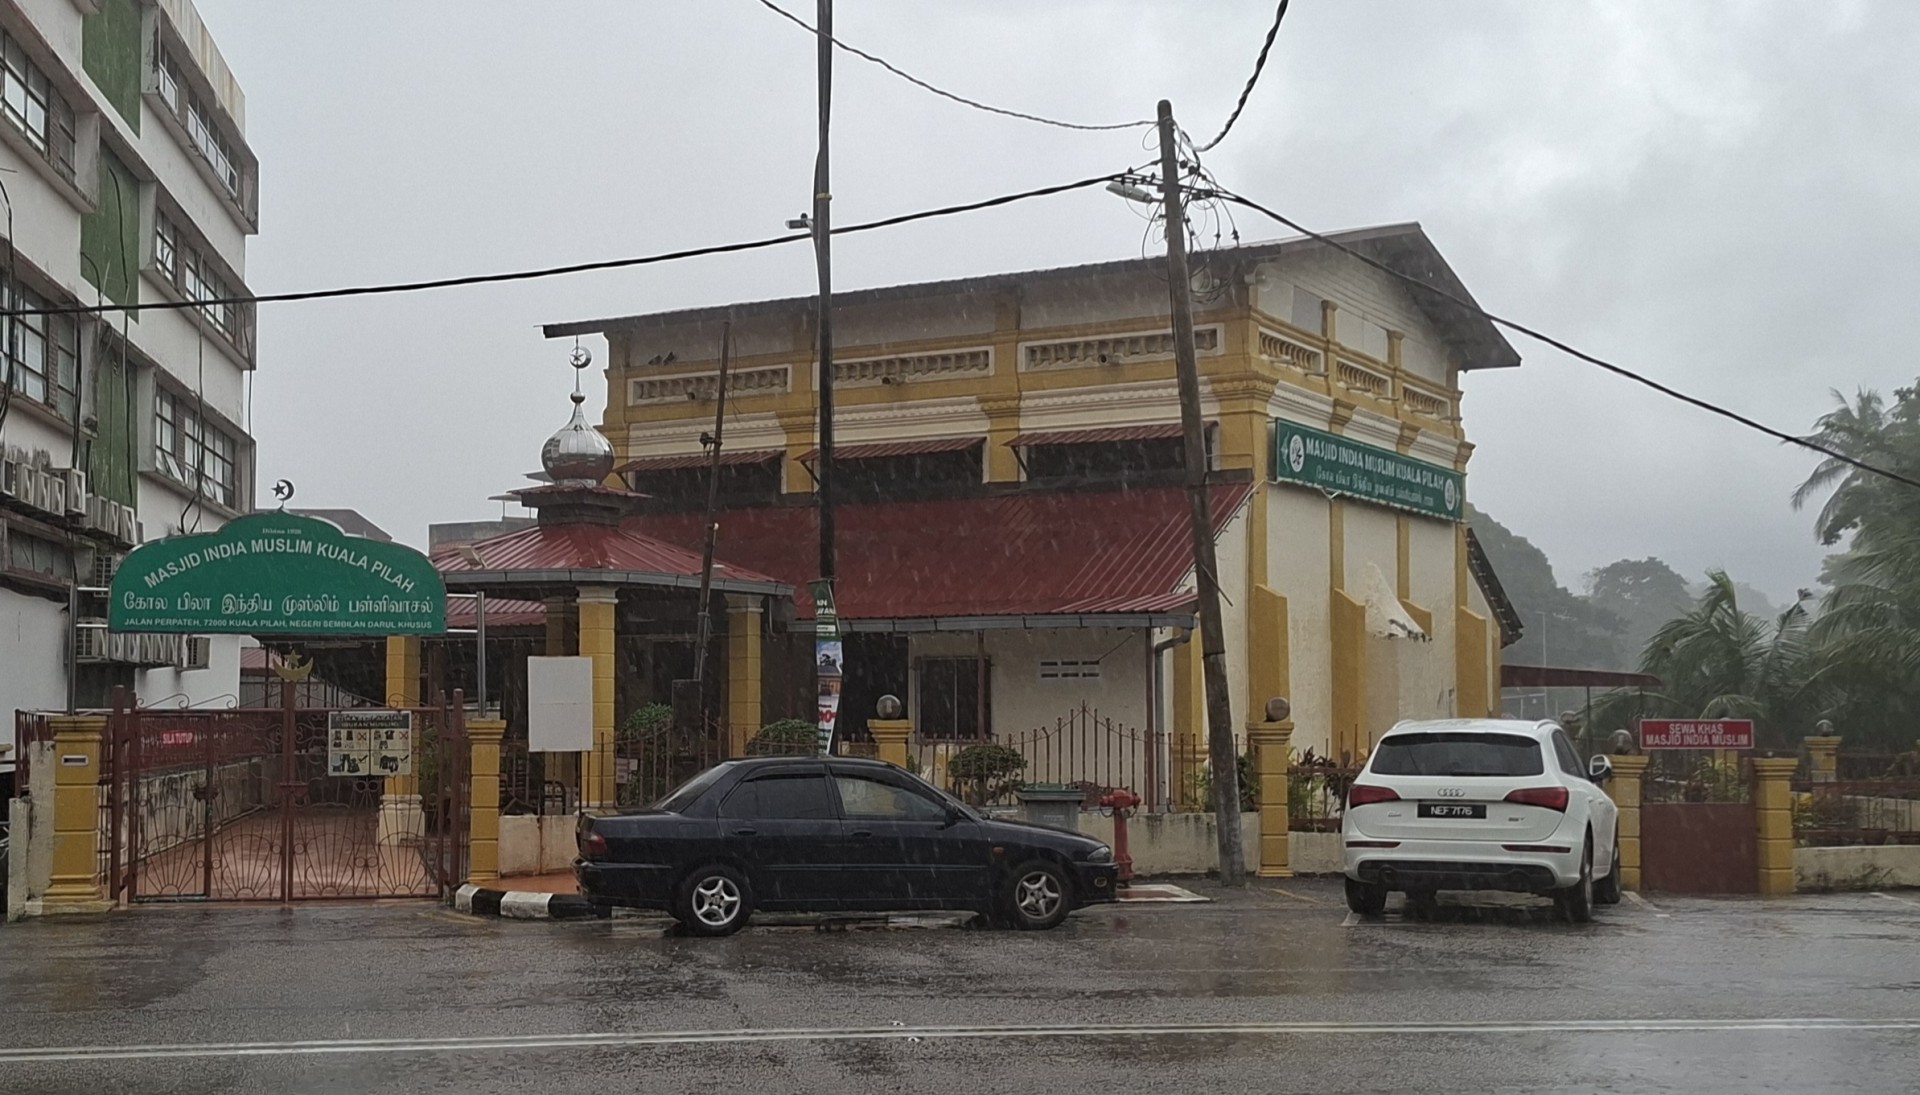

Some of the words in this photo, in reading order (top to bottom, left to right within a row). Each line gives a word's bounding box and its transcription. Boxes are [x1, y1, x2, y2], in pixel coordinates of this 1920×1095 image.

[1305, 437, 1338, 461] MASJID
[1338, 446, 1364, 469] INDIA
[1364, 453, 1395, 477] MUSLIM
[1396, 463, 1422, 484] KUALA
[1422, 470, 1444, 491] PILAH
[144, 553, 201, 589] MASJID
[203, 541, 247, 562] INDIA
[251, 538, 313, 554] MUSLIM
[316, 542, 369, 570] KUALA
[370, 560, 415, 593] PILAH
[123, 591, 168, 610] கோல
[177, 591, 212, 611] பிலா
[221, 593, 272, 615] இந்திய
[281, 594, 340, 616] முஸ்லிம்
[348, 594, 433, 613] பள்ளிவாசல்
[124, 618, 153, 626] JALAN
[154, 618, 201, 627] PERPATEH,
[204, 619, 227, 627] 72000
[260, 620, 288, 628] PILAH,
[289, 620, 322, 628] NEGERI
[323, 620, 366, 628] SEMBILAN
[367, 621, 396, 629] DARUL
[399, 621, 432, 629] KHUSUS
[1669, 723, 1695, 734] SEWA
[1697, 723, 1724, 734] KHAS
[1646, 734, 1681, 746] MASJID
[1683, 734, 1709, 745] INDIA
[1711, 734, 1749, 745] MUSLIM
[1430, 805, 1450, 816] NEF
[1451, 806, 1473, 816] 7176
